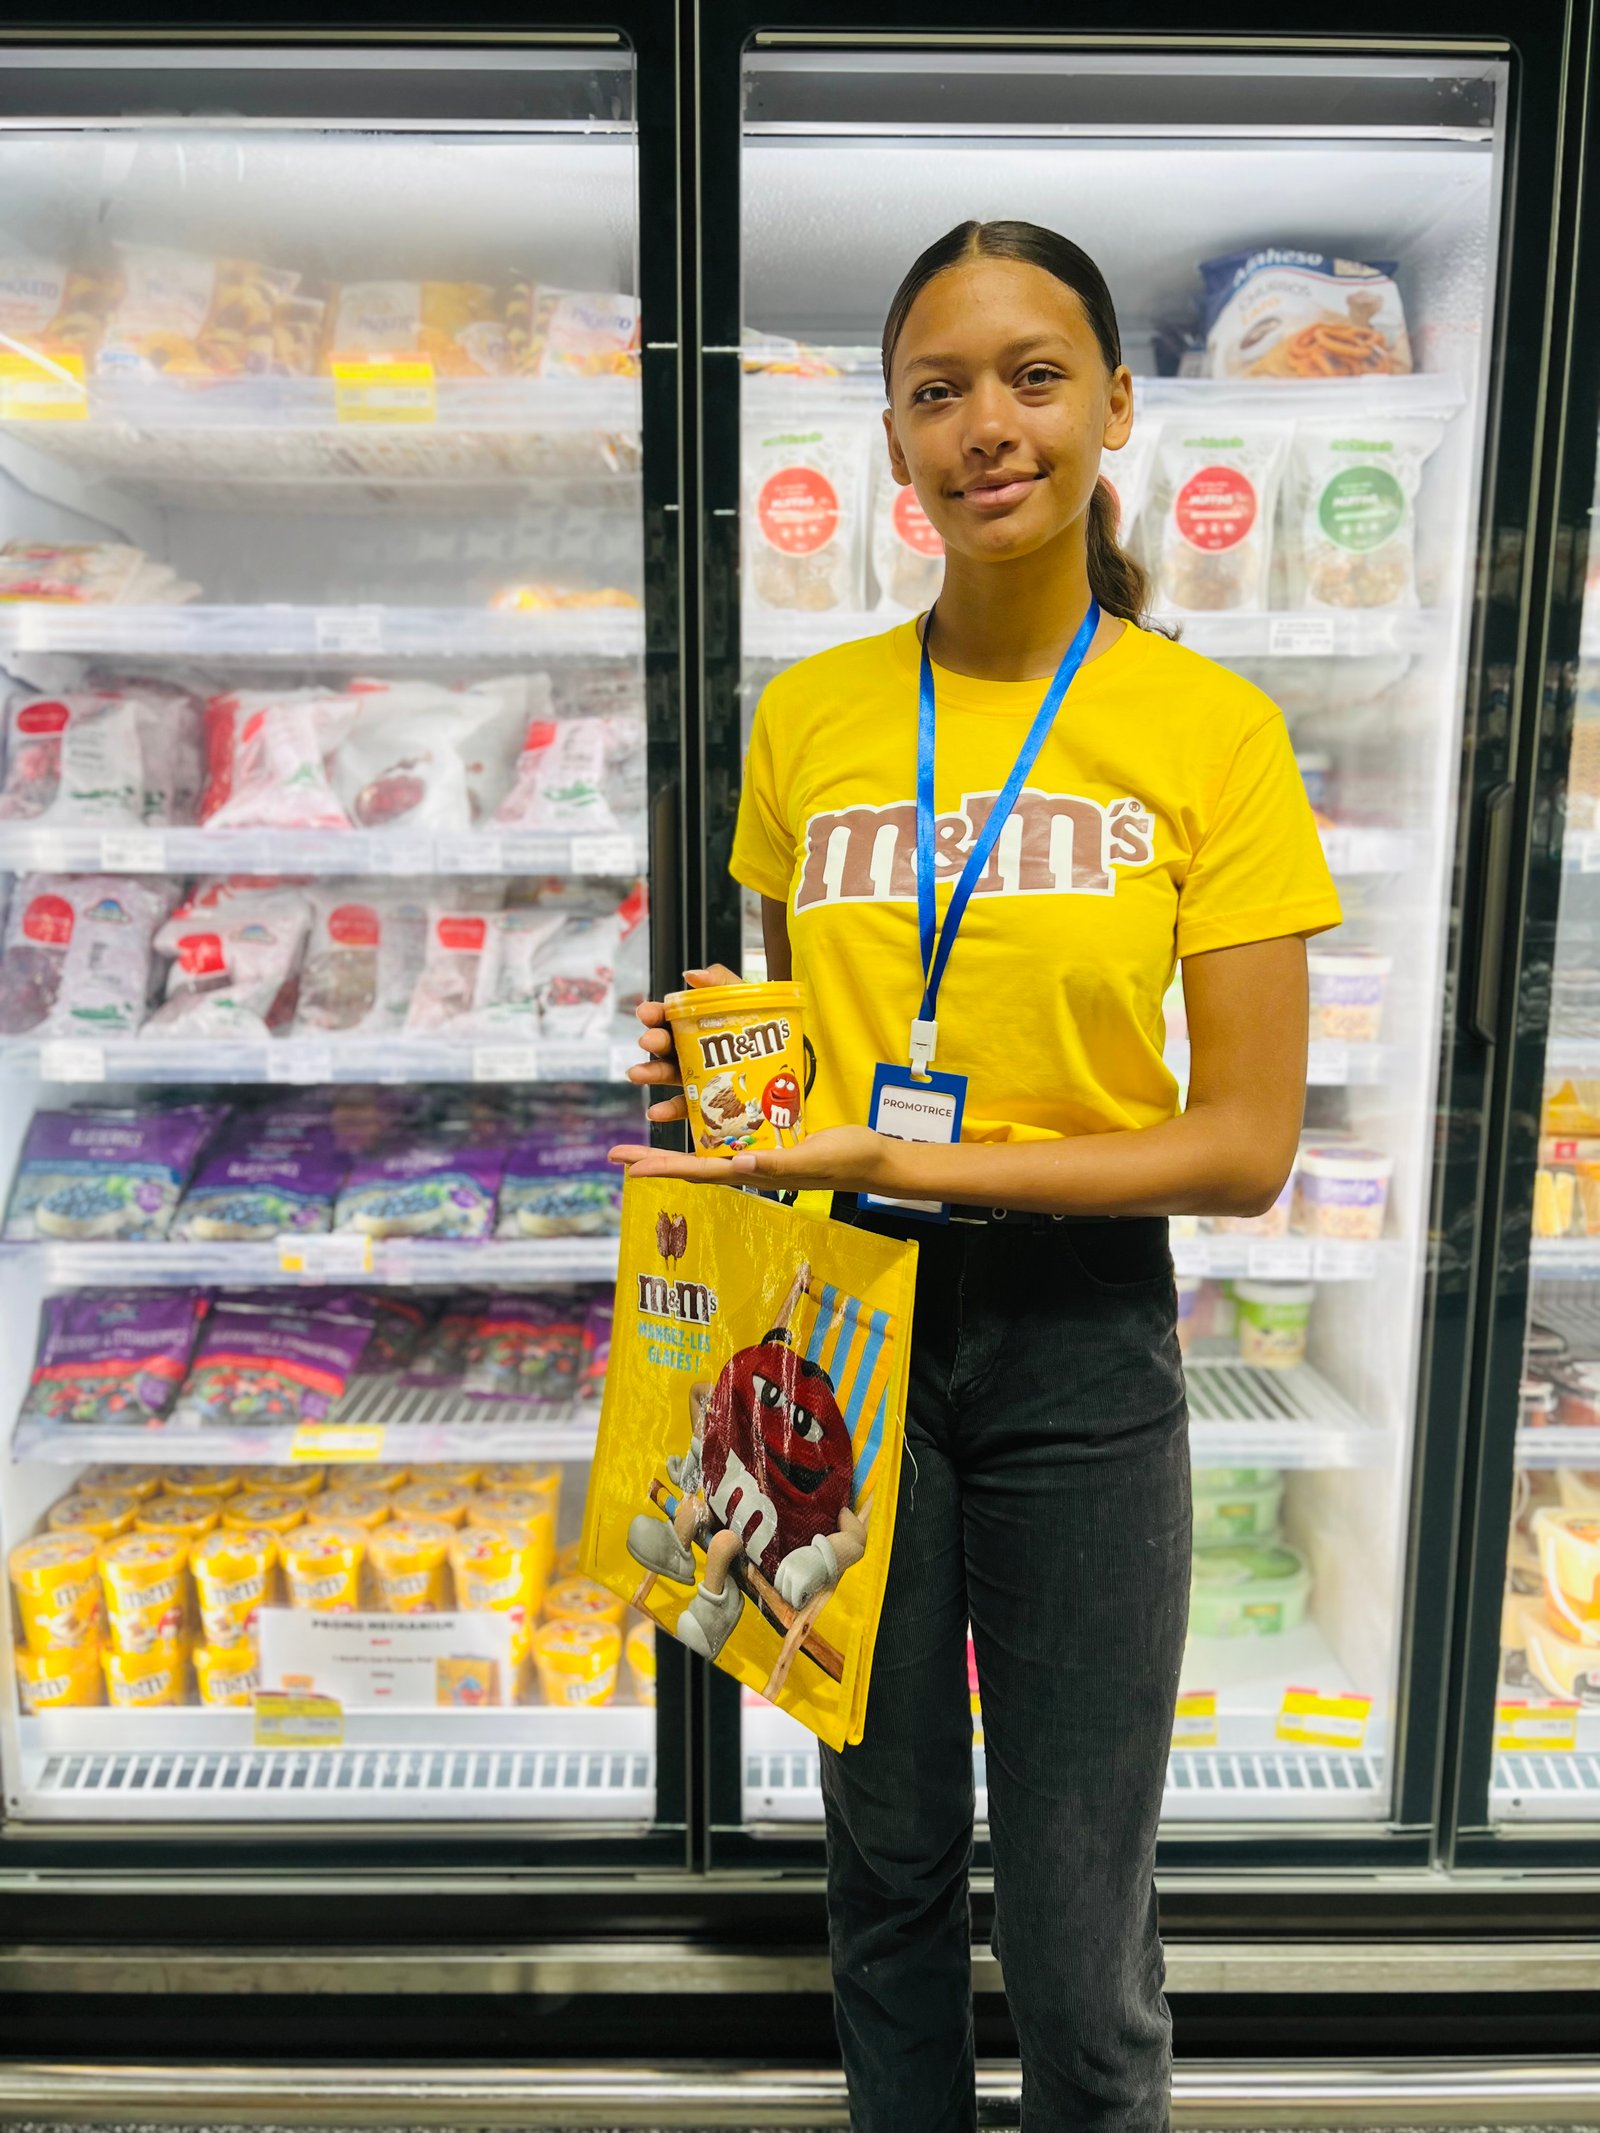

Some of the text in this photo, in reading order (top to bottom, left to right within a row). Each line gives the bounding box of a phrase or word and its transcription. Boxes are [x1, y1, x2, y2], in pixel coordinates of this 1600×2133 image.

[770, 1104, 791, 1127] m
[882, 1098, 952, 1117] PROMOTRICE
[638, 1273, 718, 1325] m&m's
[638, 1320, 711, 1352] MANGEZ-LES
[710, 1448, 778, 1566] m
